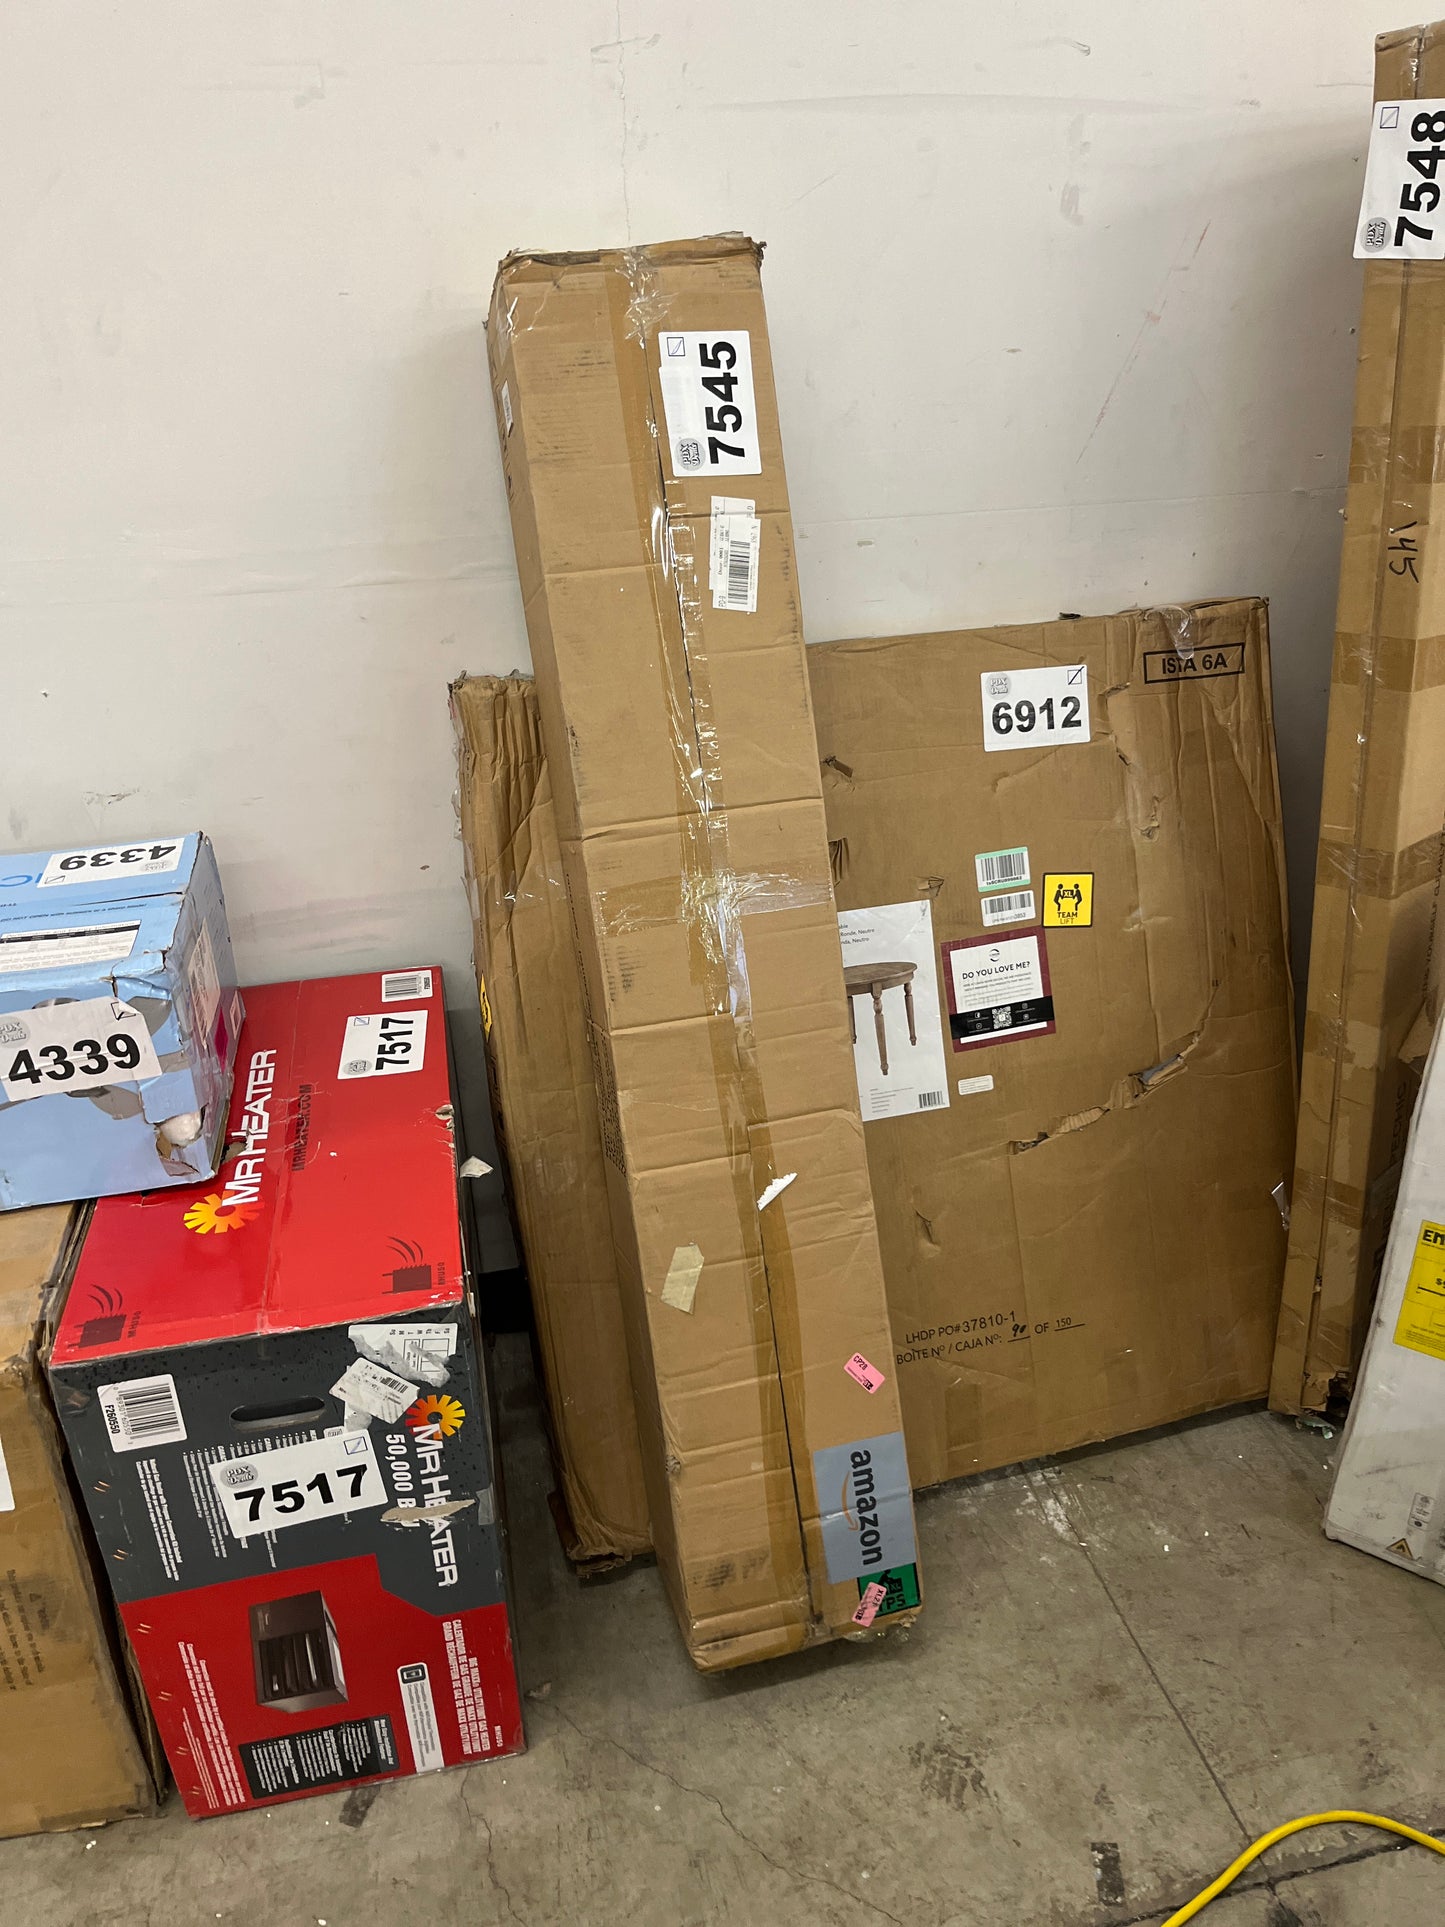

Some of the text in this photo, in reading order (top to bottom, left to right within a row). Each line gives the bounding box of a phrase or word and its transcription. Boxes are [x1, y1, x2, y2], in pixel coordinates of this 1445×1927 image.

[1394, 110, 1445, 246] 7548
[699, 341, 745, 464] 7545
[1202, 653, 1228, 670] 6A
[992, 696, 1082, 734] 6912
[60, 845, 177, 871] 4339
[1064, 890, 1072, 898] XL
[962, 961, 1030, 980] DO YOU LOVE ME?
[8, 1034, 140, 1084] 4339
[375, 1018, 414, 1070] 7517
[906, 1329, 936, 1344] LHDP
[948, 1344, 953, 1354] /
[956, 1340, 984, 1352] CAJA
[1035, 1322, 1050, 1334] OF
[1056, 1317, 1072, 1328] 150
[104, 1404, 120, 1434] F260550
[385, 1434, 414, 1492] 50,000
[234, 1464, 368, 1522] 7517
[850, 1450, 882, 1566] amazon
